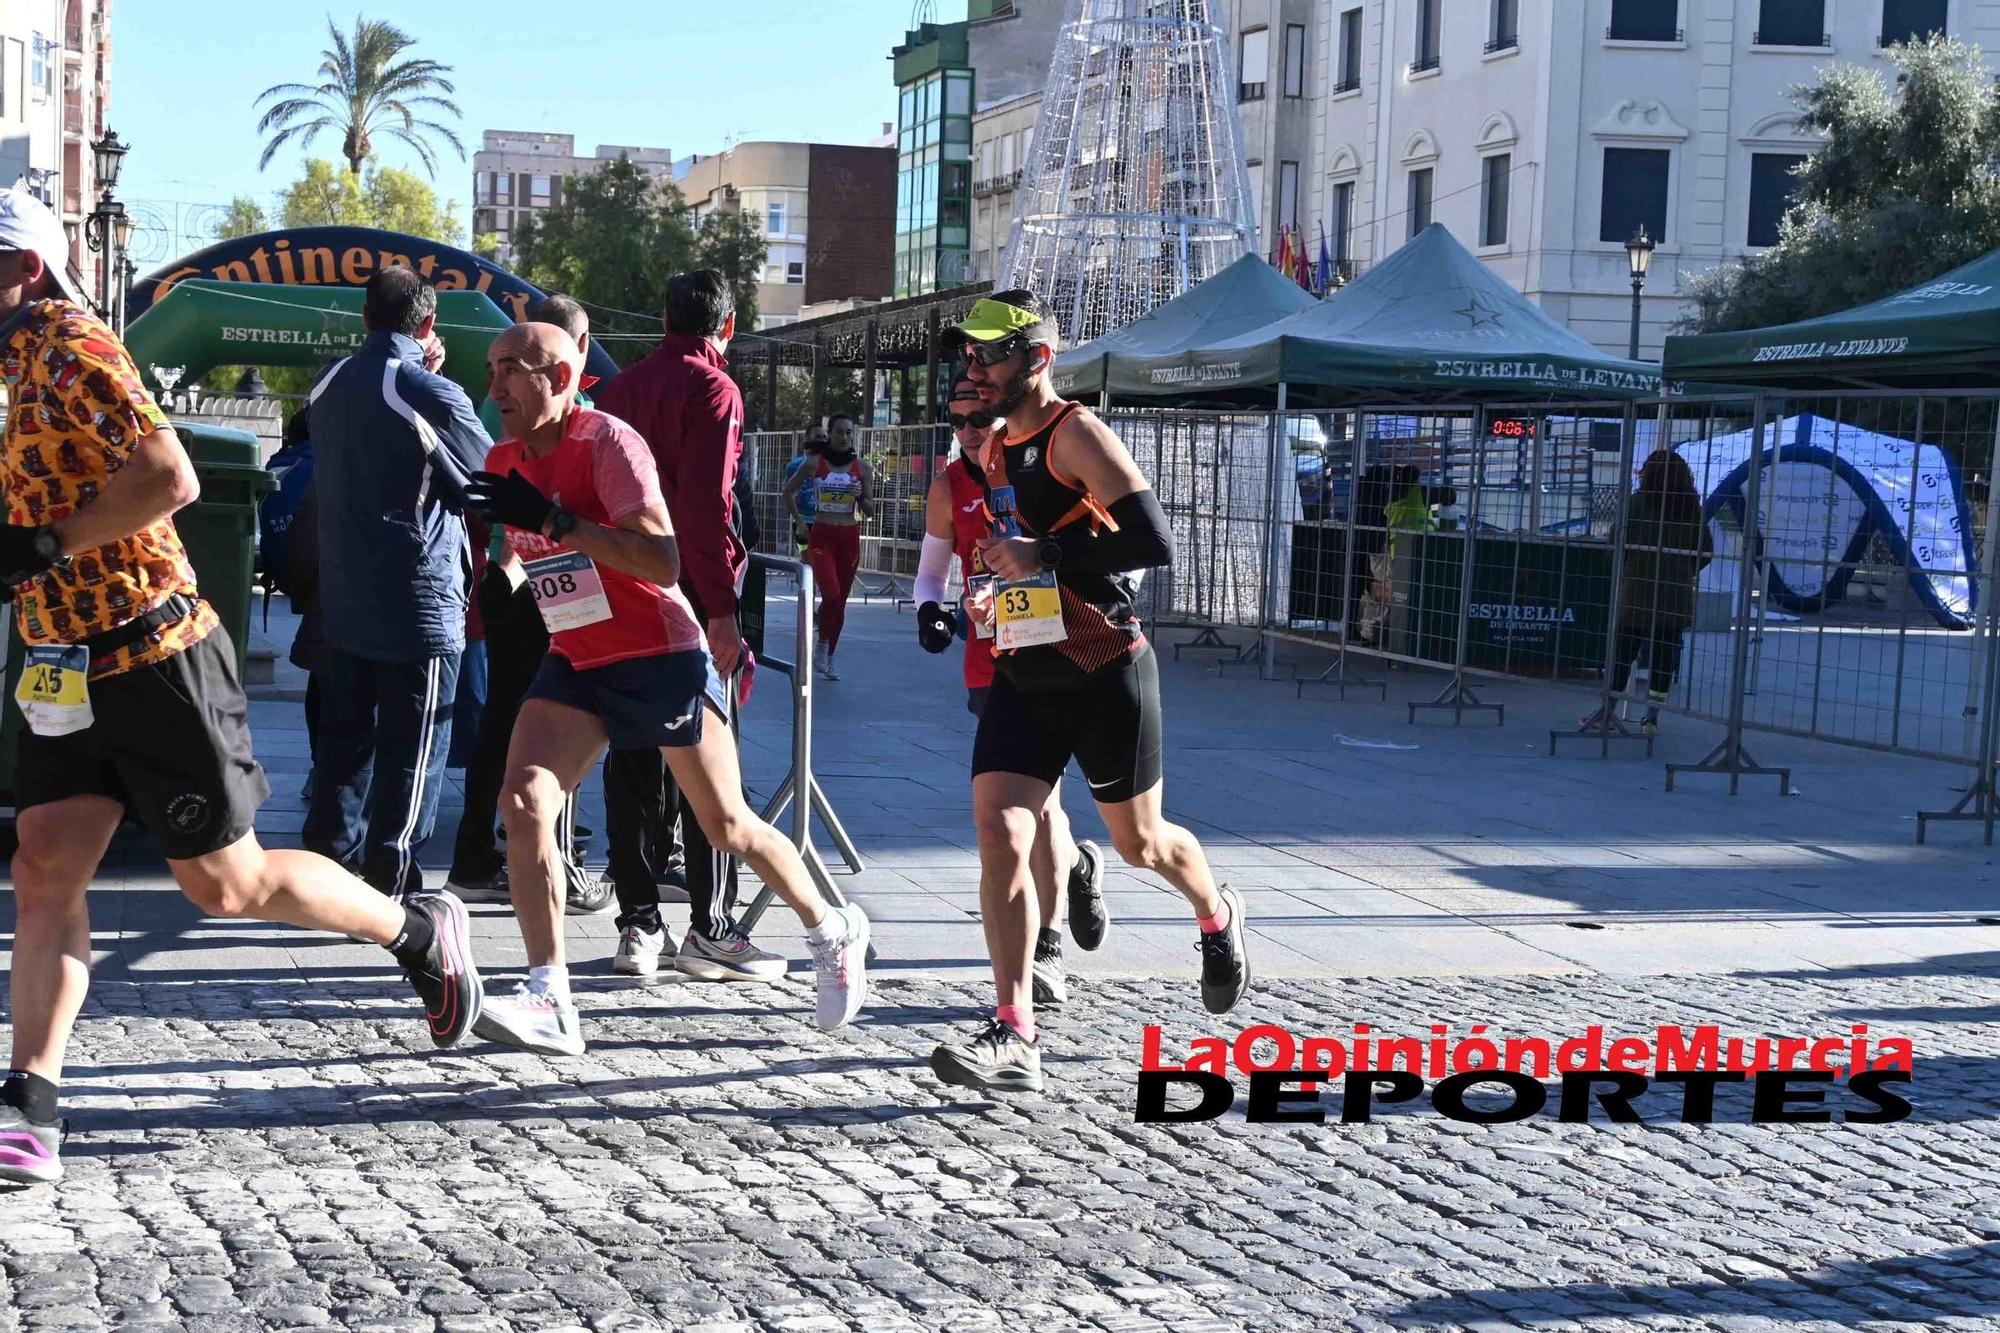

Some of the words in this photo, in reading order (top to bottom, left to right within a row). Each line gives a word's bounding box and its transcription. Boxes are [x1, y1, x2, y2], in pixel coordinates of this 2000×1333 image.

[221, 326, 332, 346] ESTRELLA
[333, 336, 346, 344] DE
[1753, 342, 1827, 362] ESTRELLA
[1832, 337, 1909, 357] LEVANTE
[1150, 366, 1196, 384] ESTRELLA
[1201, 361, 1241, 381] LEVANTE
[1434, 360, 1558, 381] ESTRELLA
[1561, 369, 1577, 380] DE
[1577, 367, 1685, 396] LEVANTE
[1005, 590, 1030, 614] 53
[1468, 603, 1575, 622] ESTRELLA
